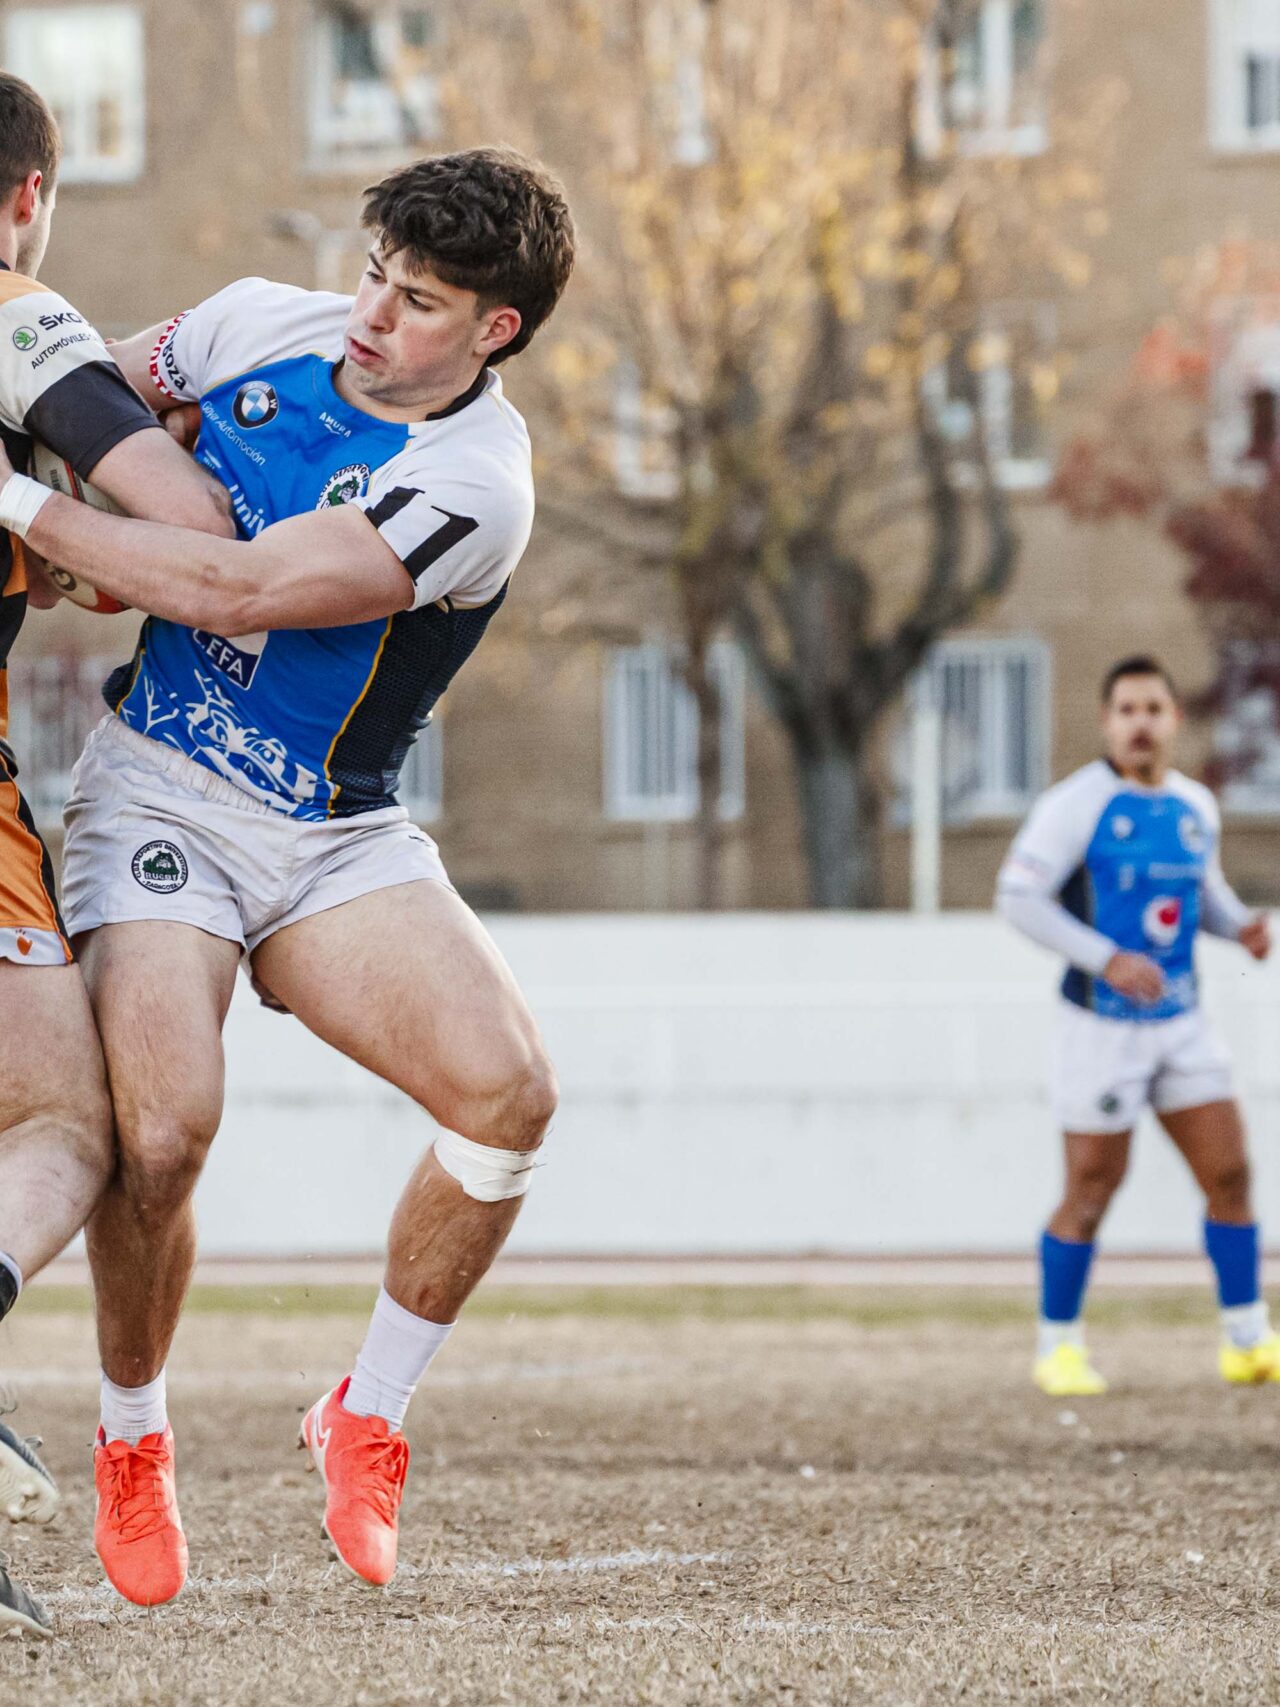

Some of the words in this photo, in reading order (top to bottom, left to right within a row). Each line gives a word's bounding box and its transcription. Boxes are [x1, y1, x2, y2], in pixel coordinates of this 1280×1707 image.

[38, 312, 82, 331] ŠKO
[318, 411, 352, 438] AMURA
[364, 486, 480, 587] 11
